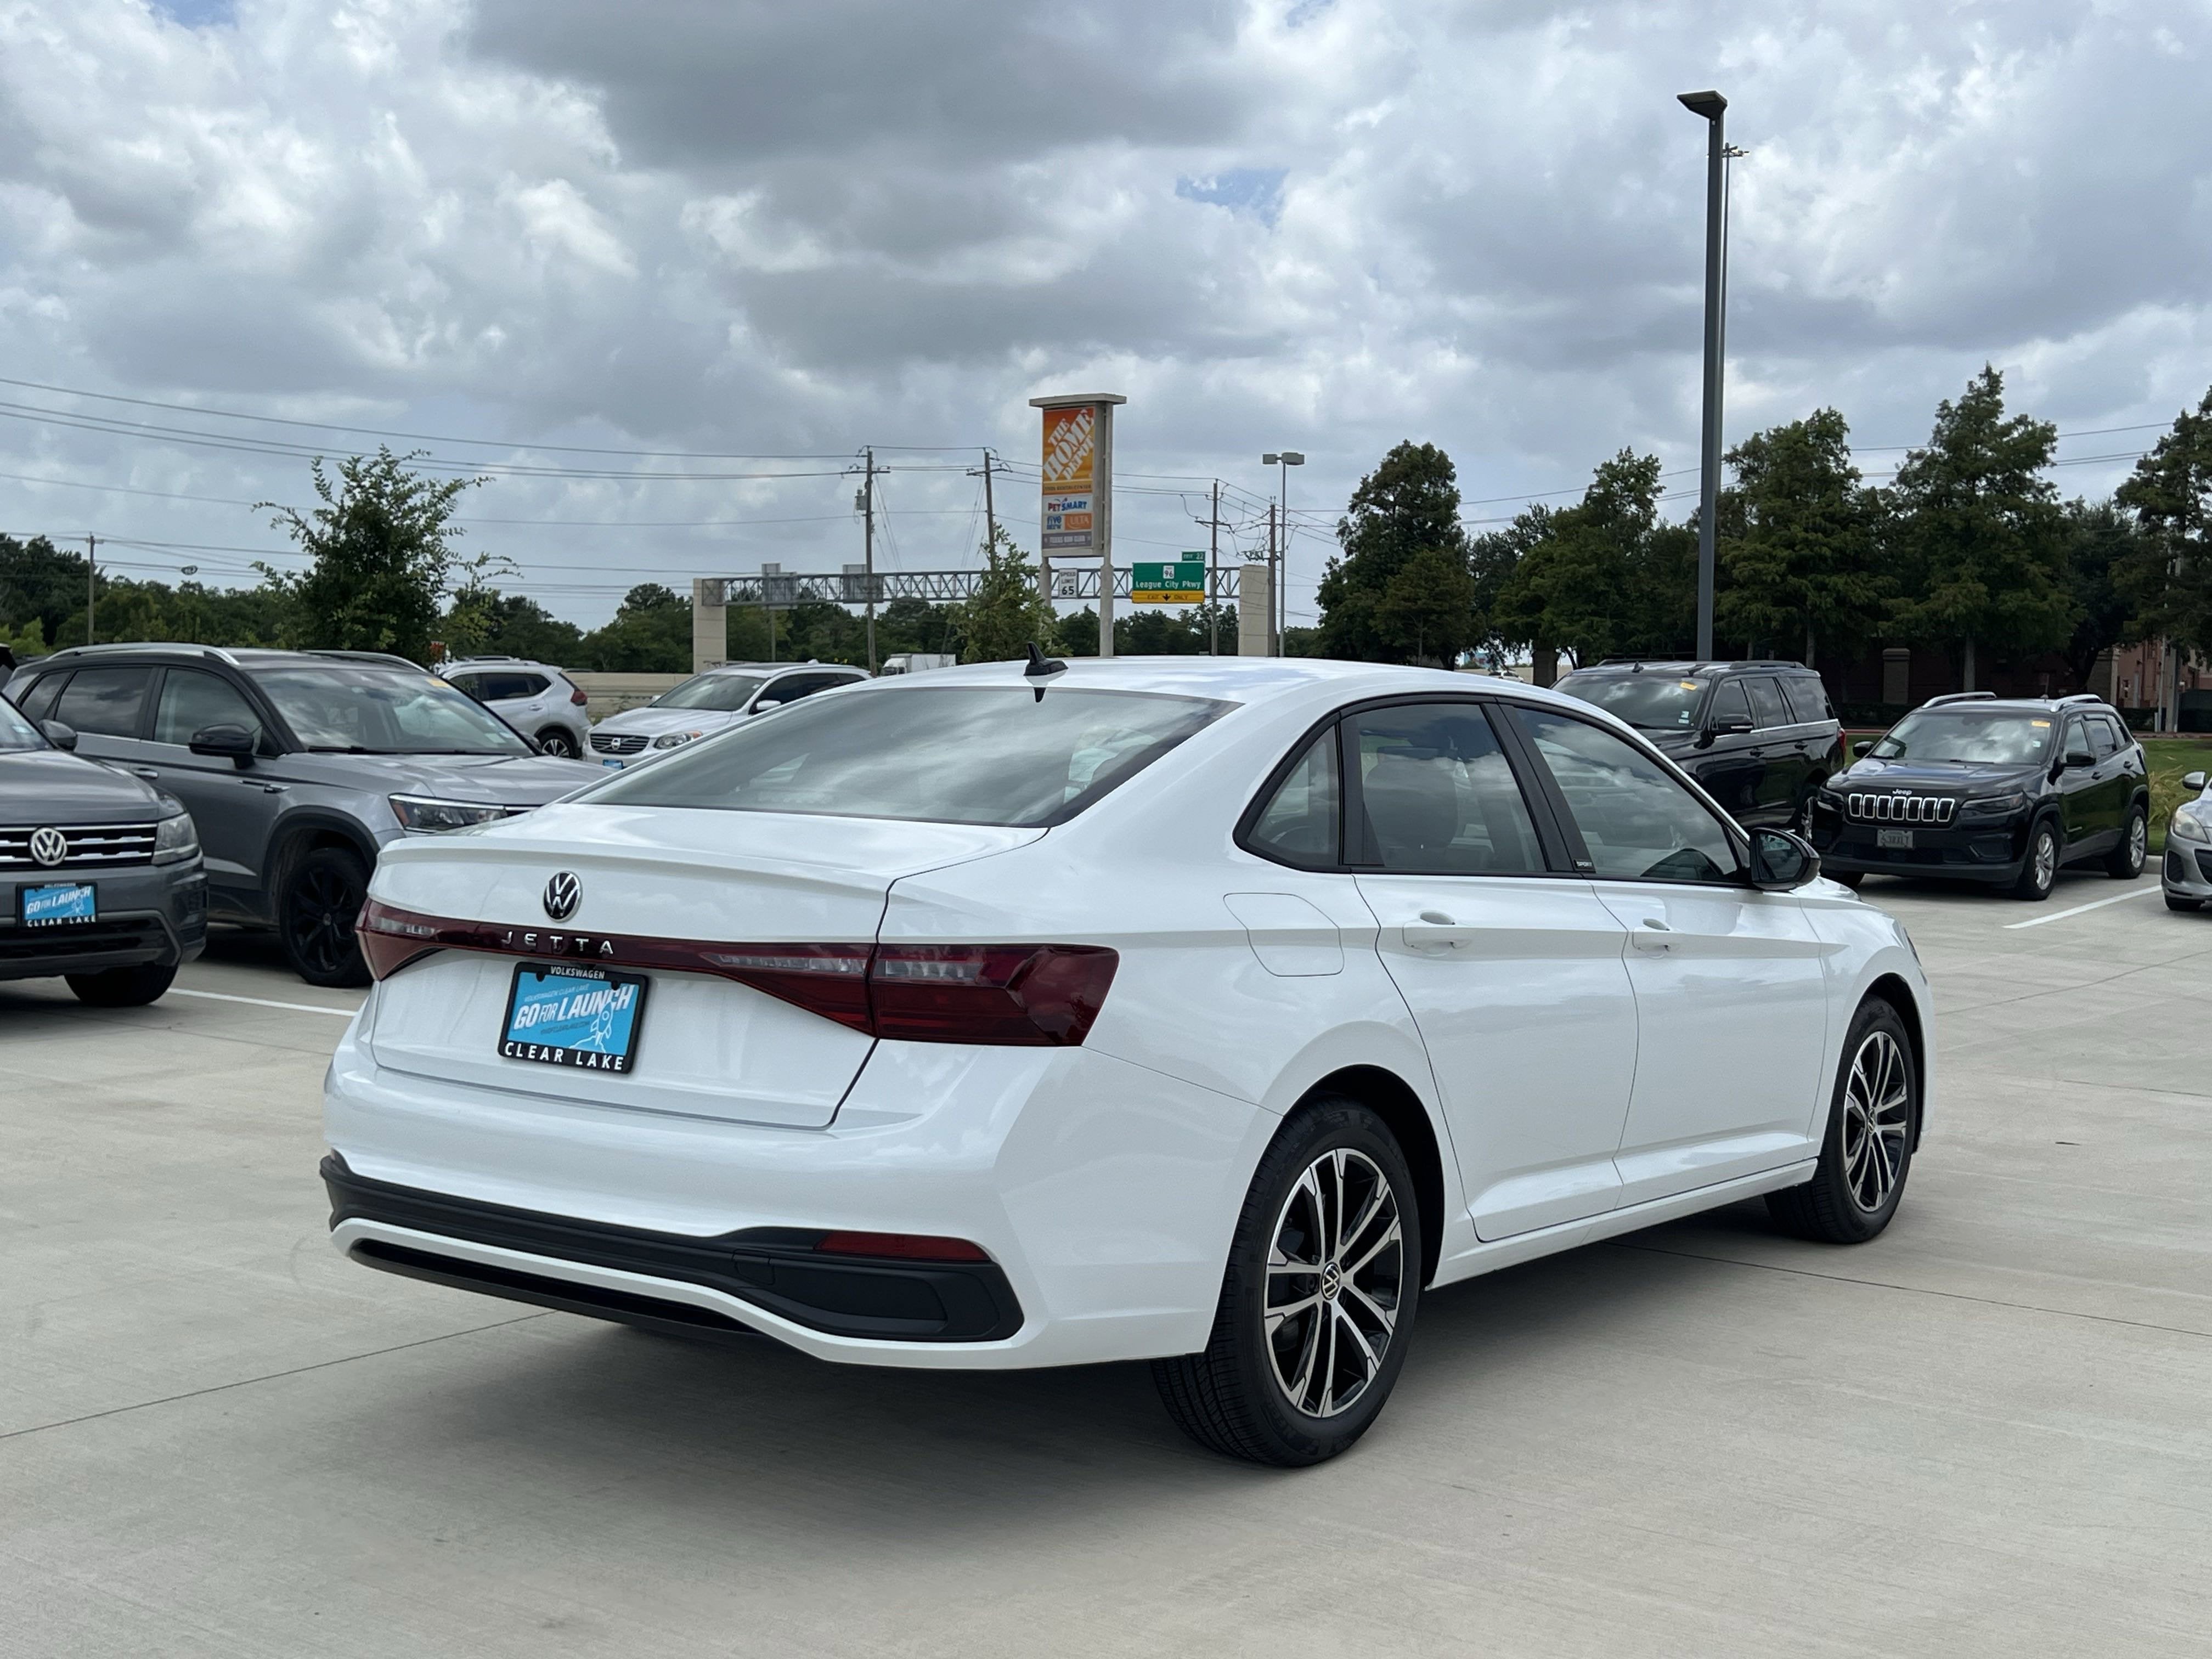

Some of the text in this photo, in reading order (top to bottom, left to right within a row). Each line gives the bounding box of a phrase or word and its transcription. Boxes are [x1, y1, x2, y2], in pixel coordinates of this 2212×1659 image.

[1043, 409, 1094, 481] HOME
[1063, 435, 1094, 480] DEPOT
[1070, 515, 1089, 524] ULTA
[1062, 586, 1074, 595] 65
[1136, 580, 1201, 589] League City Pkwy
[26, 900, 41, 914] GO
[52, 886, 92, 907] LAUNCH
[544, 871, 583, 922] VW
[27, 915, 96, 927] CLEAR LAKE
[501, 931, 613, 955] JETTA
[550, 966, 605, 979] VOLKSWAGEN
[514, 984, 635, 1030] GO FOR LAUNCH
[505, 1042, 624, 1070] CLEAR LAKE
